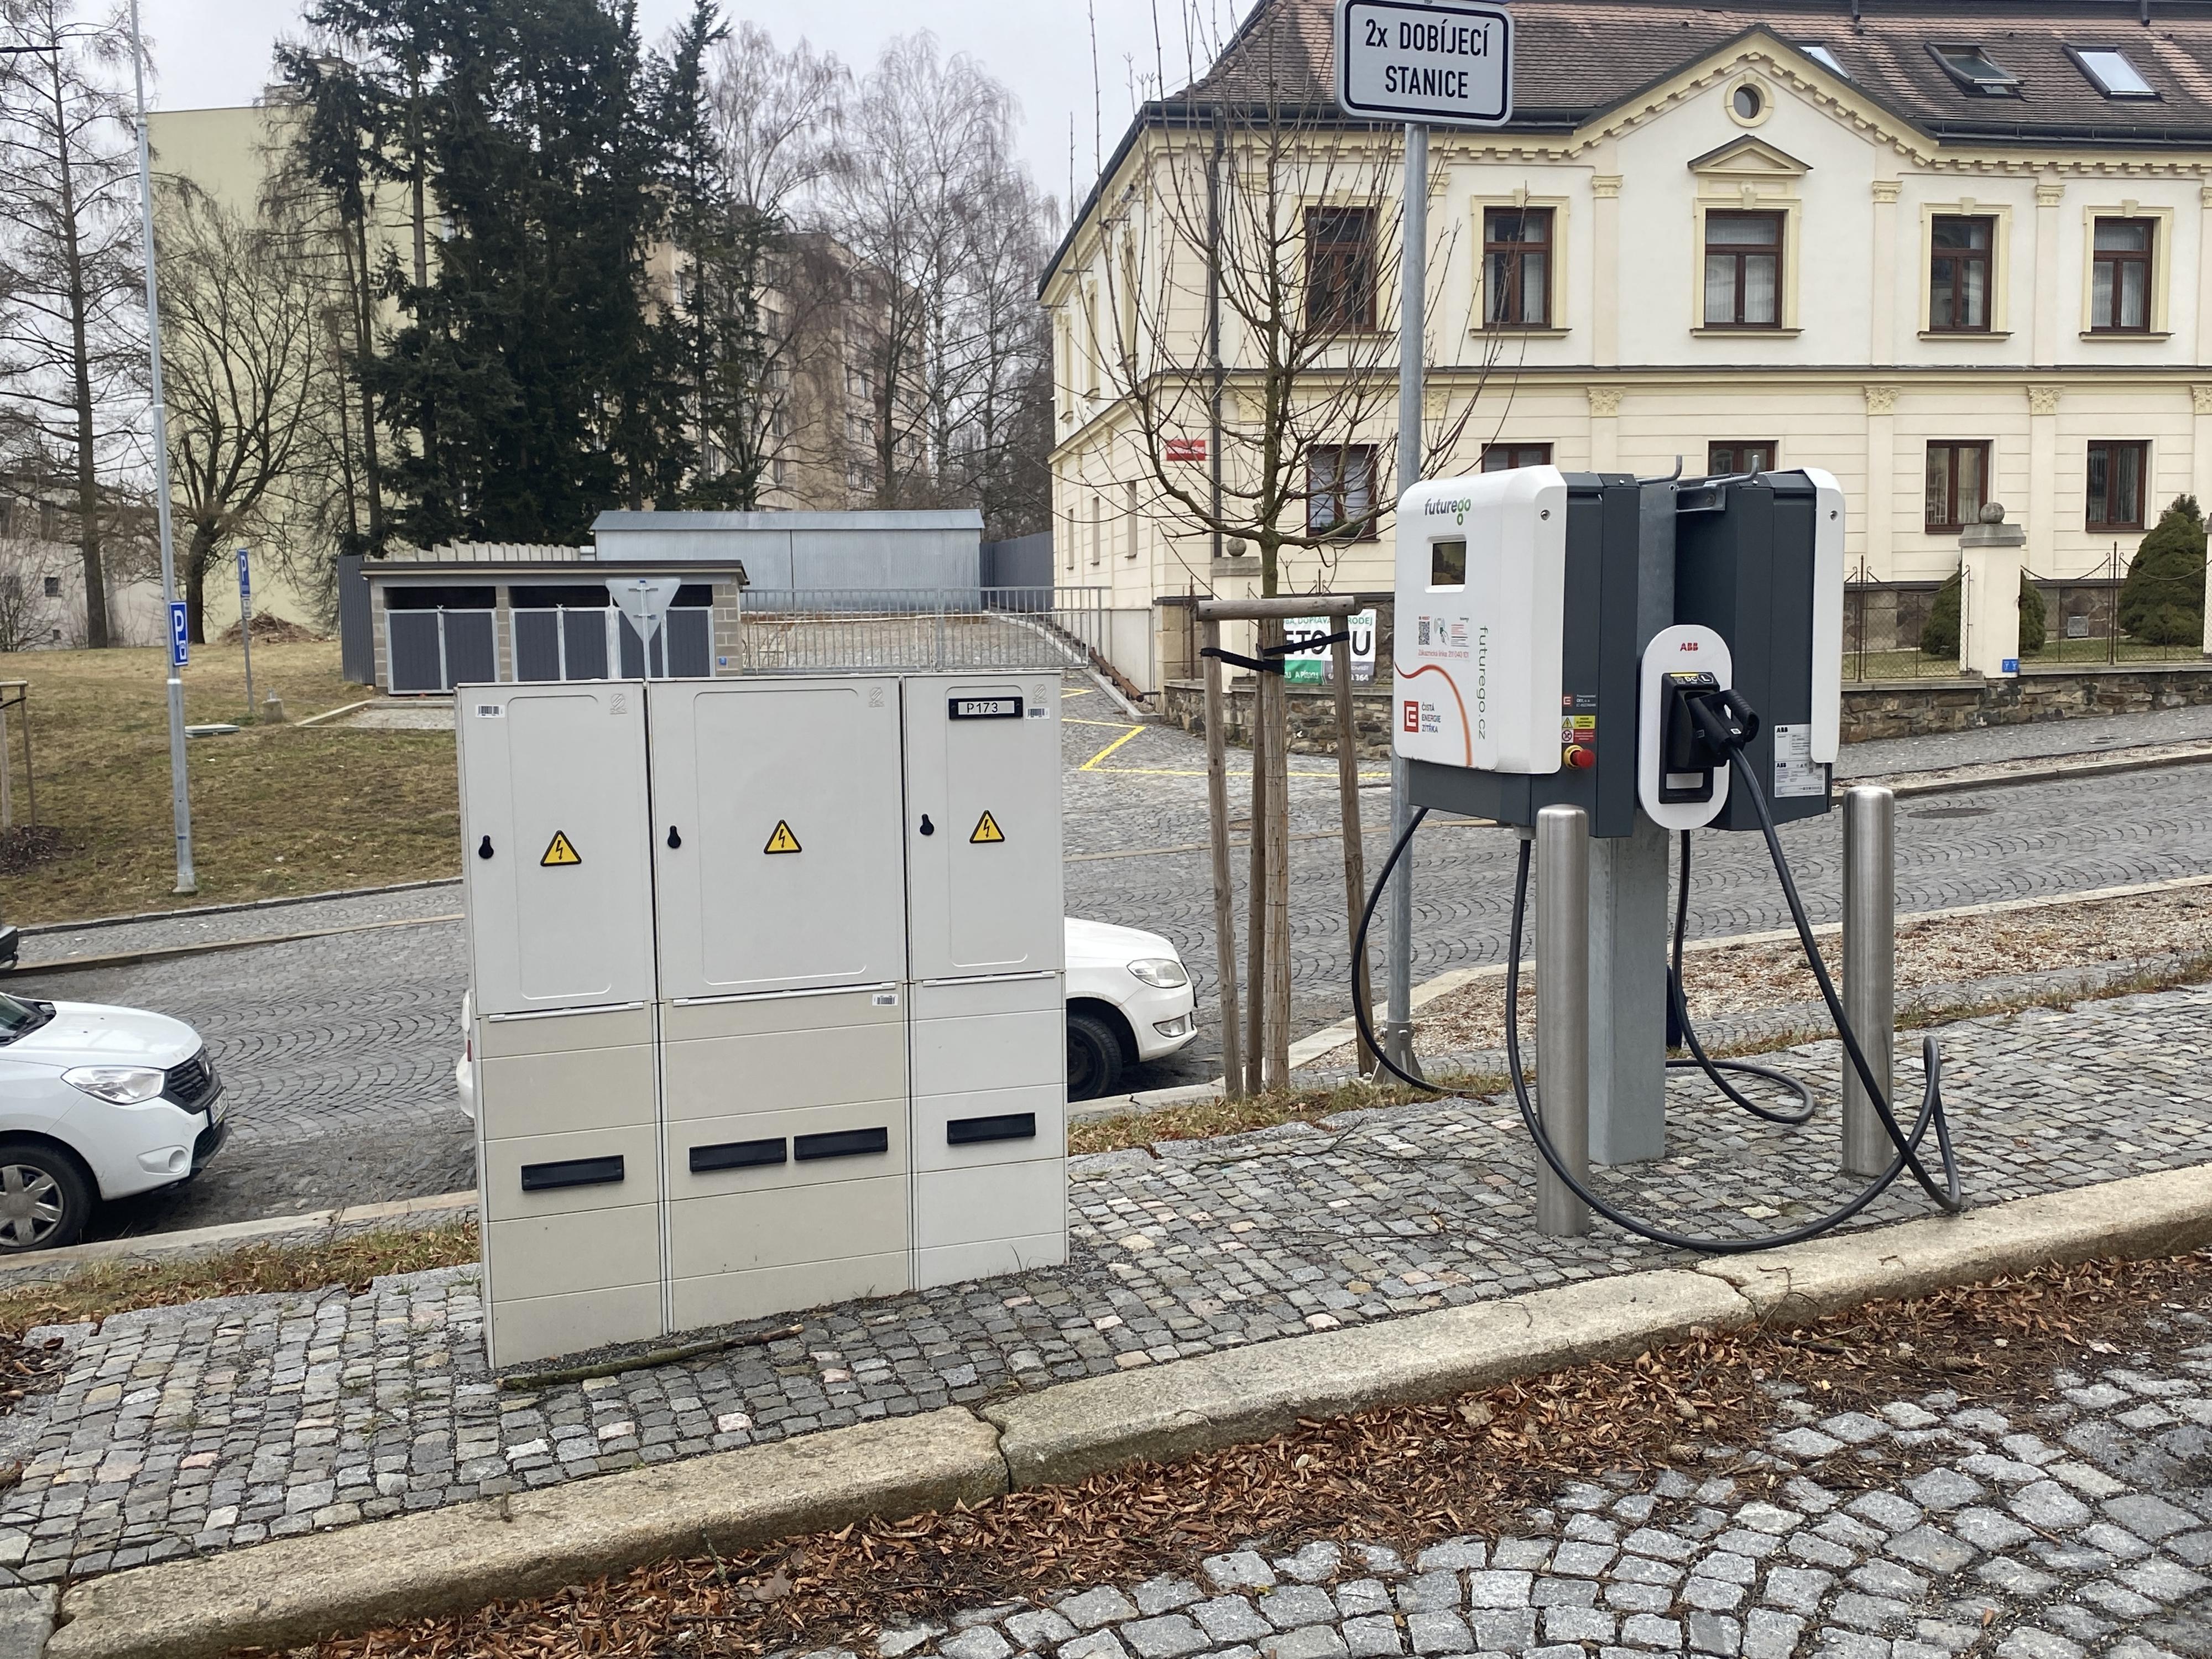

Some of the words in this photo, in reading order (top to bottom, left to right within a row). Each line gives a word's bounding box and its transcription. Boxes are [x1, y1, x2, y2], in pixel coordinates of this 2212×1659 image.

[1365, 19, 1388, 48] 2x
[1400, 19, 1490, 57] DOBÍJECÍ
[1385, 65, 1469, 99] STANICE
[1425, 497, 1471, 526] futurego
[240, 555, 247, 582] P
[174, 610, 184, 645] P
[1680, 643, 1698, 651] ABB
[1477, 625, 1489, 740] futurego.cz
[967, 702, 998, 713] P173
[1421, 714, 1441, 723] ENERGIE
